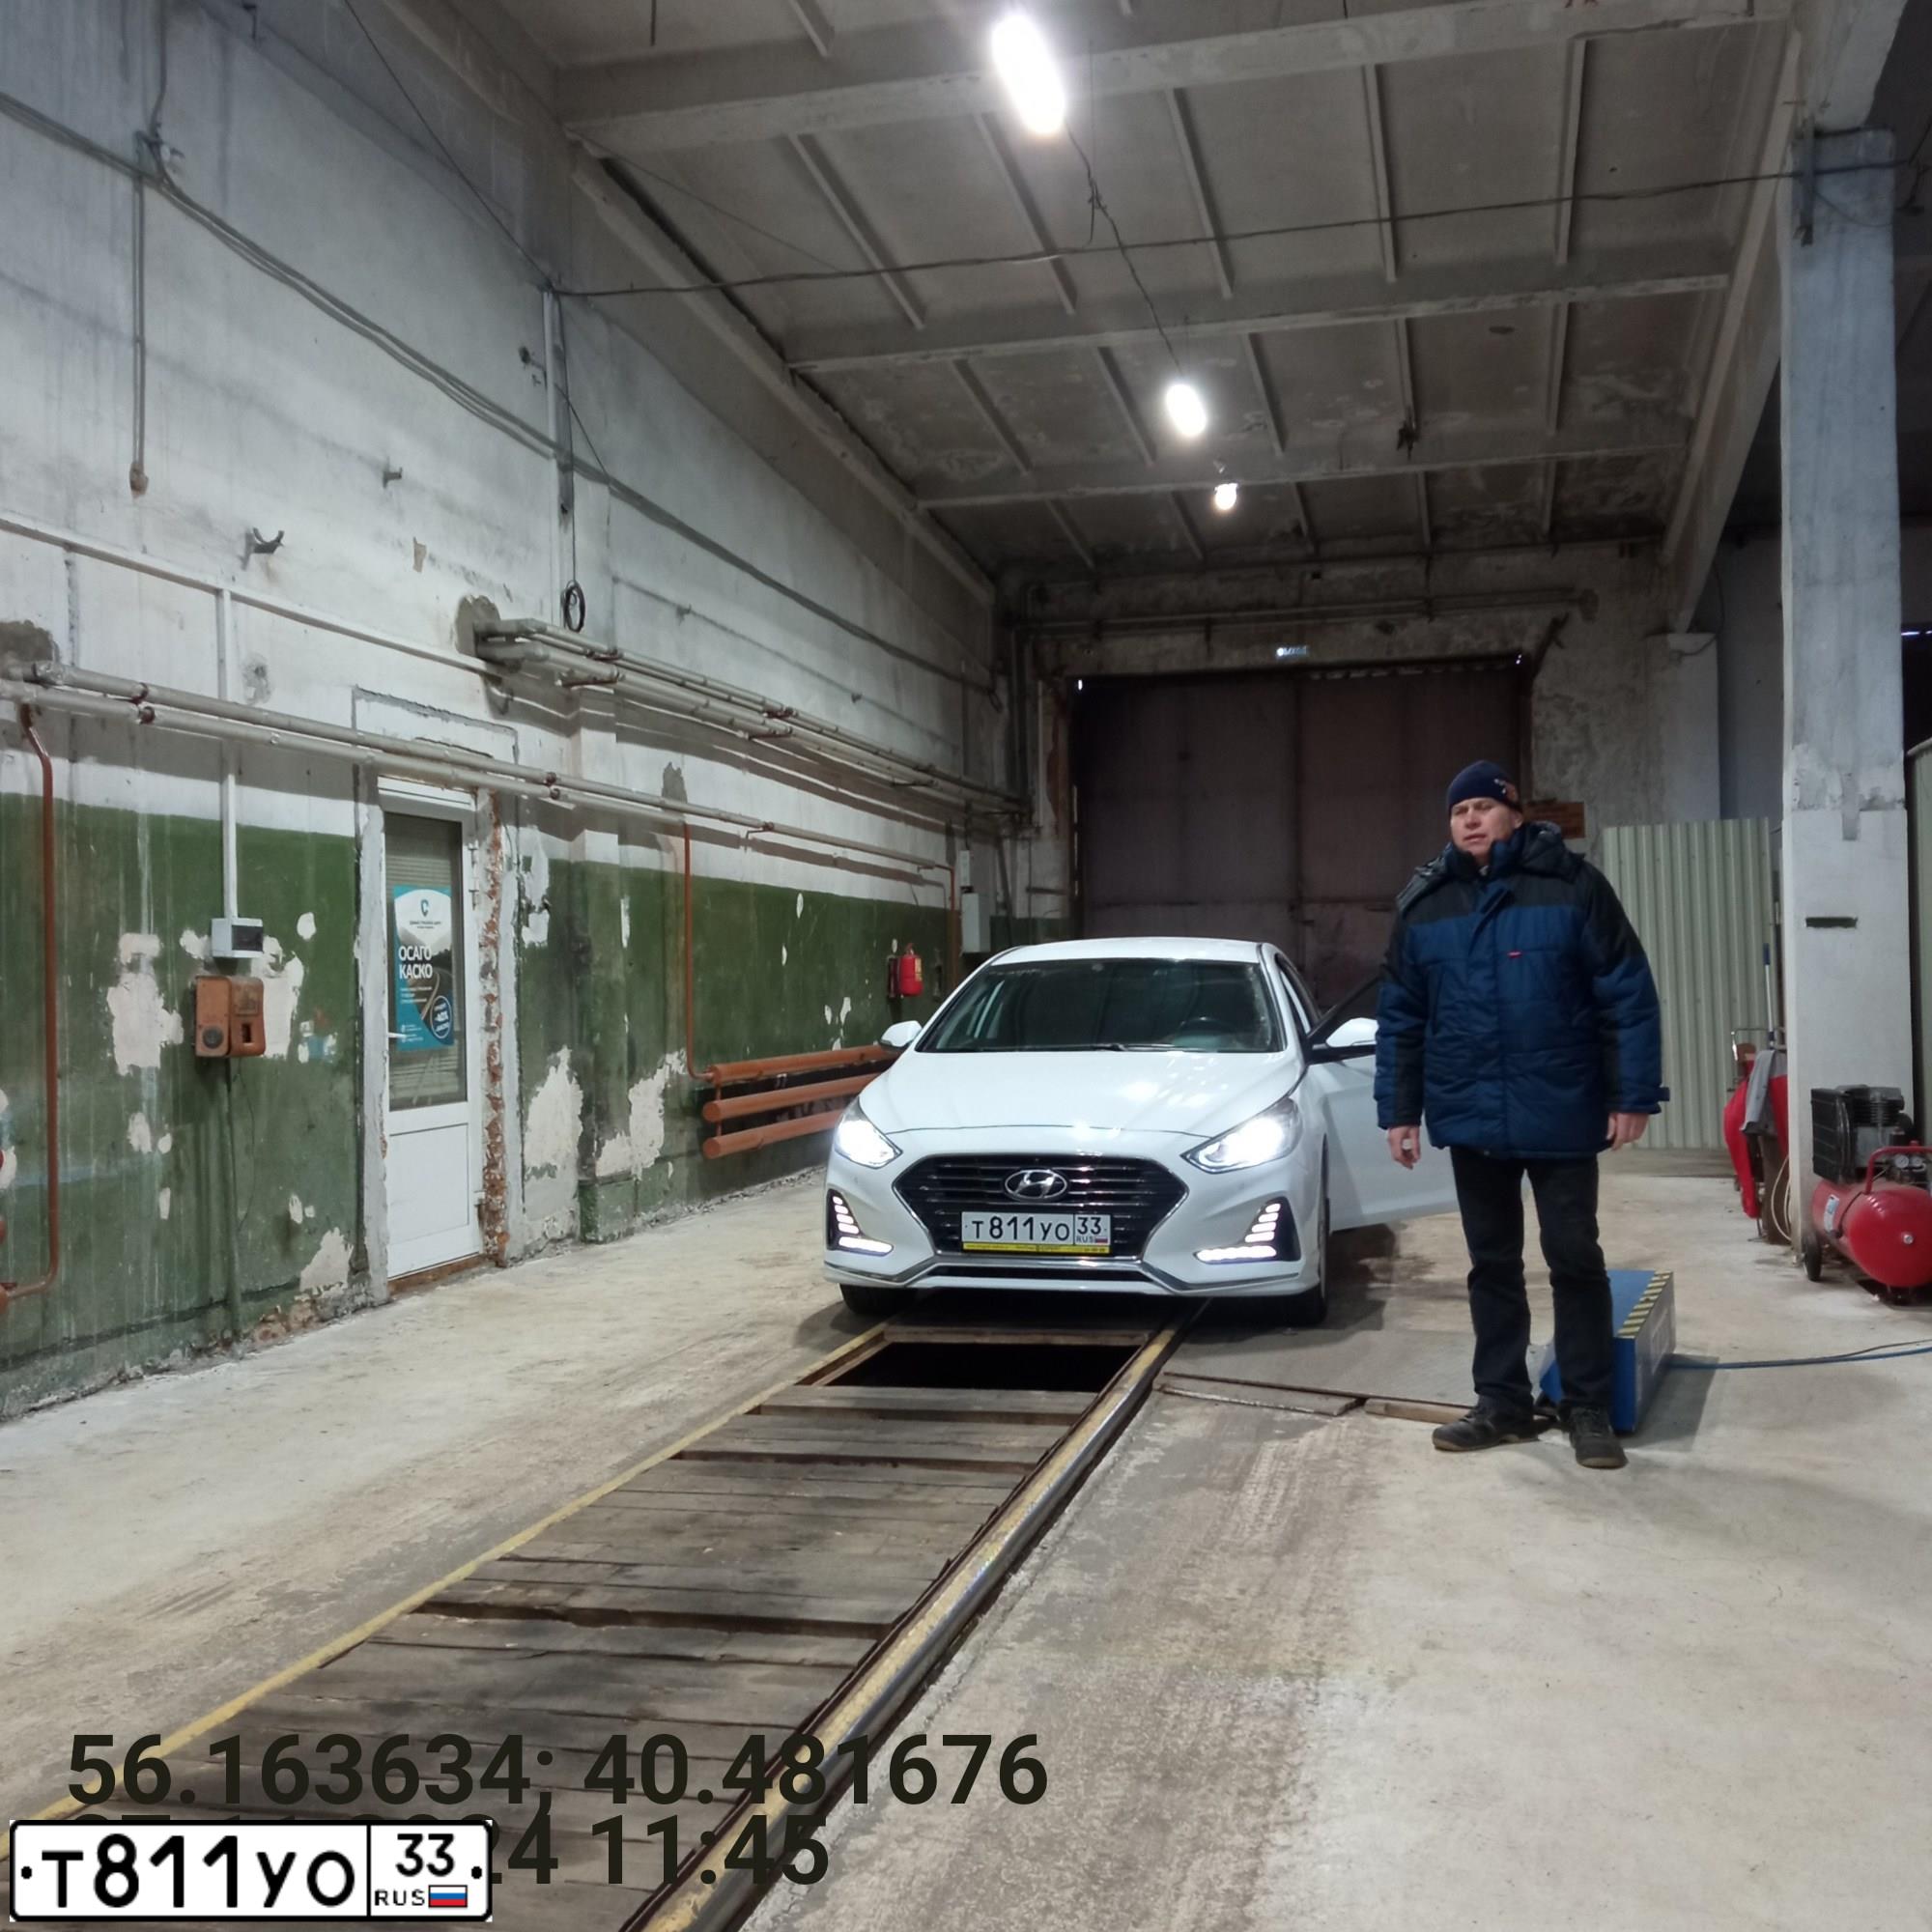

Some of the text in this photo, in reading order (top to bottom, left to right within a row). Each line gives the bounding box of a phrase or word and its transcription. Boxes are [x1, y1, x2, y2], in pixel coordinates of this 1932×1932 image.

[399, 946, 432, 961] ОСАГО
[399, 962, 433, 980] КАСКО
[972, 1216, 1102, 1241] Т811УО 33
